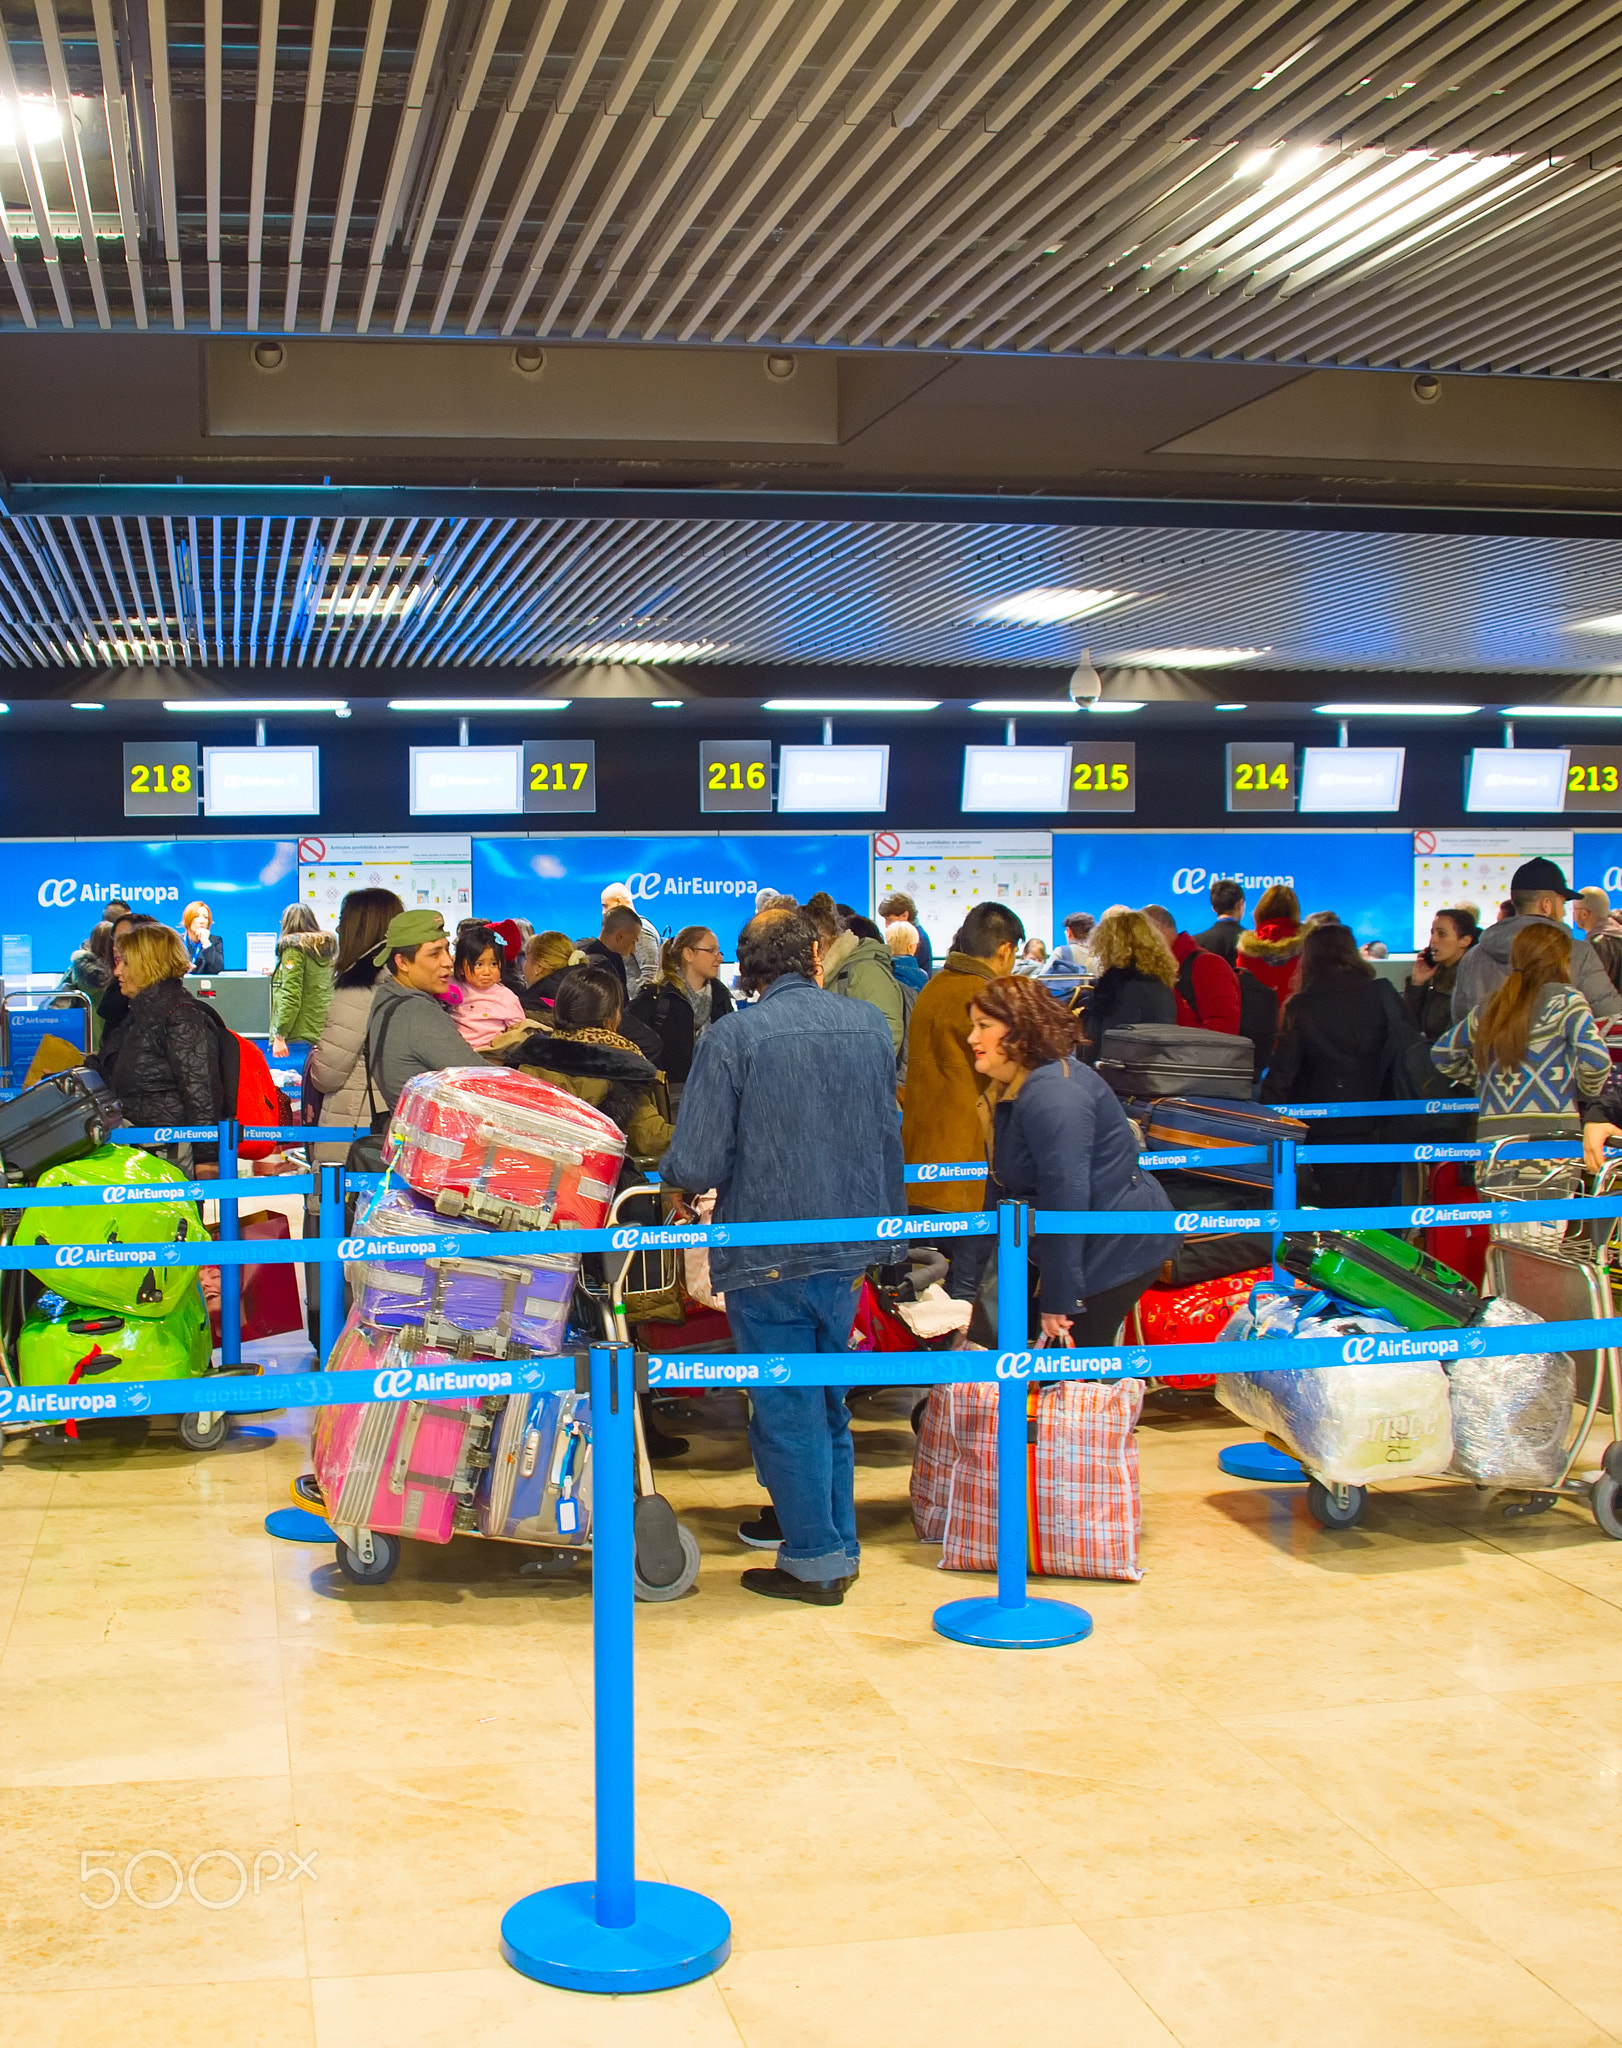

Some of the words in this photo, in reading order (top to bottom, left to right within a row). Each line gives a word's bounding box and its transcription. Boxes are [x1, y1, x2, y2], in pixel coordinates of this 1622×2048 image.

[131, 765, 191, 792] 218
[531, 763, 587, 790] 217
[709, 763, 765, 789] 216
[1075, 764, 1128, 790] 215
[1236, 764, 1289, 789] 214
[1568, 765, 1619, 792] 213
[80, 882, 179, 904] AirEuropa
[664, 876, 757, 898] AirEuropa
[174, 1131, 218, 1139] AirEuropa
[1435, 1148, 1481, 1157] AirEuropa
[127, 1186, 185, 1202] AirEuropa
[1200, 1216, 1260, 1229] AirEuropa
[1436, 1210, 1492, 1221] AirEuropa
[904, 1221, 968, 1233] AirEuropa
[641, 1232, 707, 1245] AirEuropa
[85, 1247, 157, 1264] AirEuropa
[367, 1242, 436, 1255] AirEuropa
[1378, 1340, 1458, 1356] AirEuropa
[665, 1362, 759, 1382] AirEuropa
[1034, 1356, 1122, 1374] AirEuropa
[415, 1372, 512, 1391] AirEuropa
[16, 1394, 116, 1413] AirEuropa
